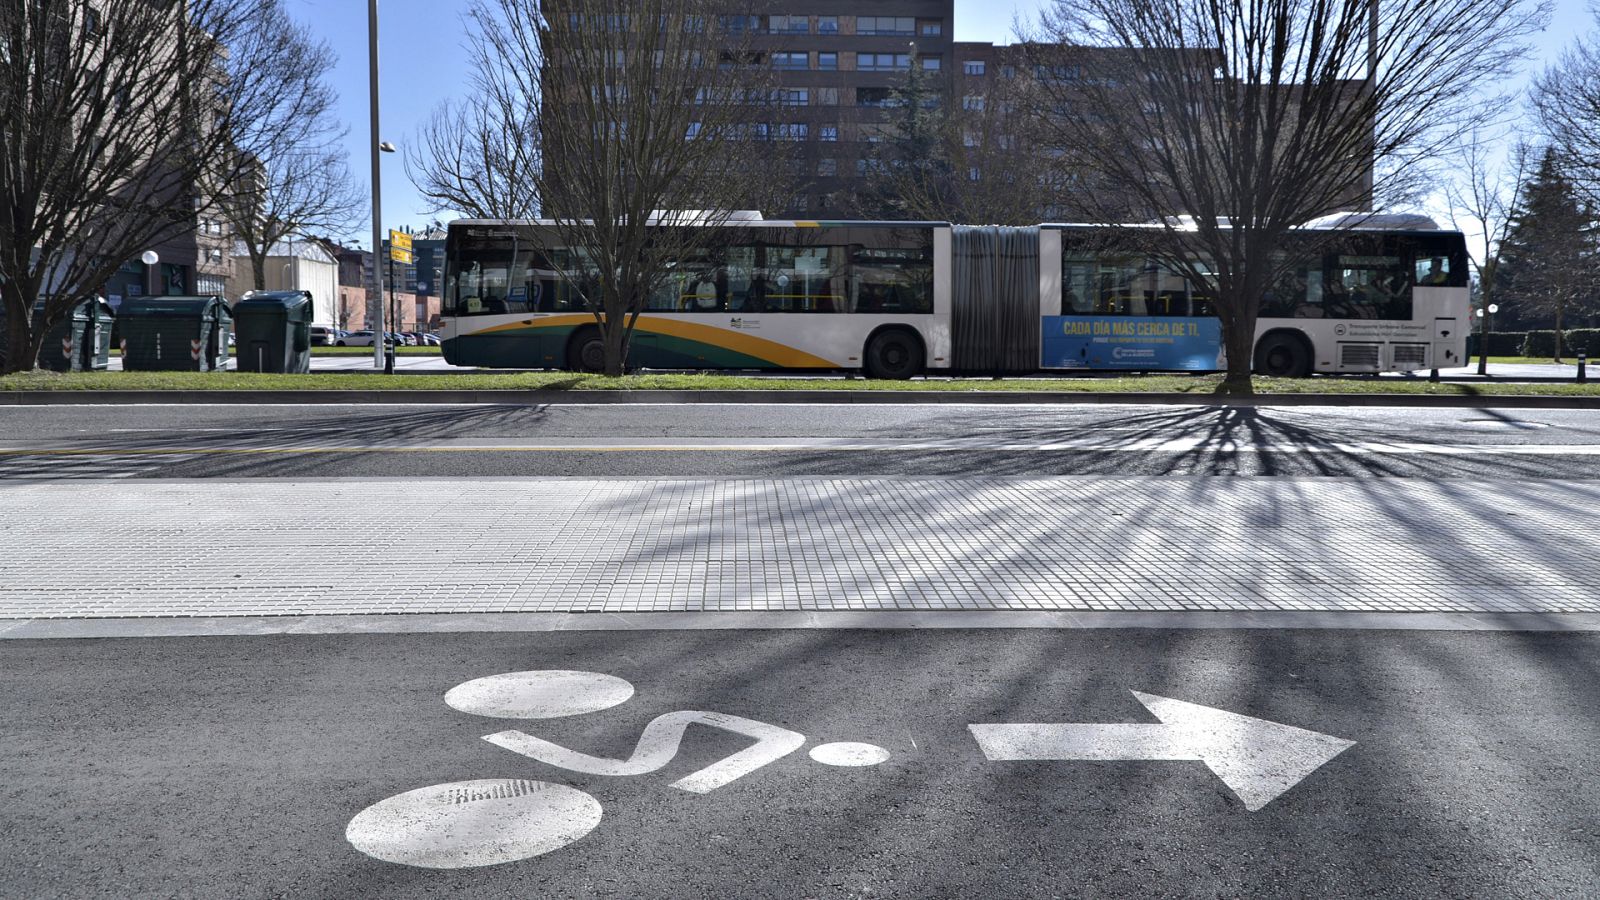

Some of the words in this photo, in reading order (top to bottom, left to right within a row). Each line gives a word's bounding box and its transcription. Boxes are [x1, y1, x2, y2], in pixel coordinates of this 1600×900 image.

[1064, 321, 1091, 335] CADA
[1094, 320, 1111, 335] DÍA
[1113, 320, 1135, 336] MÁS
[1137, 321, 1169, 336] CERCA
[1172, 321, 1185, 336] DE
